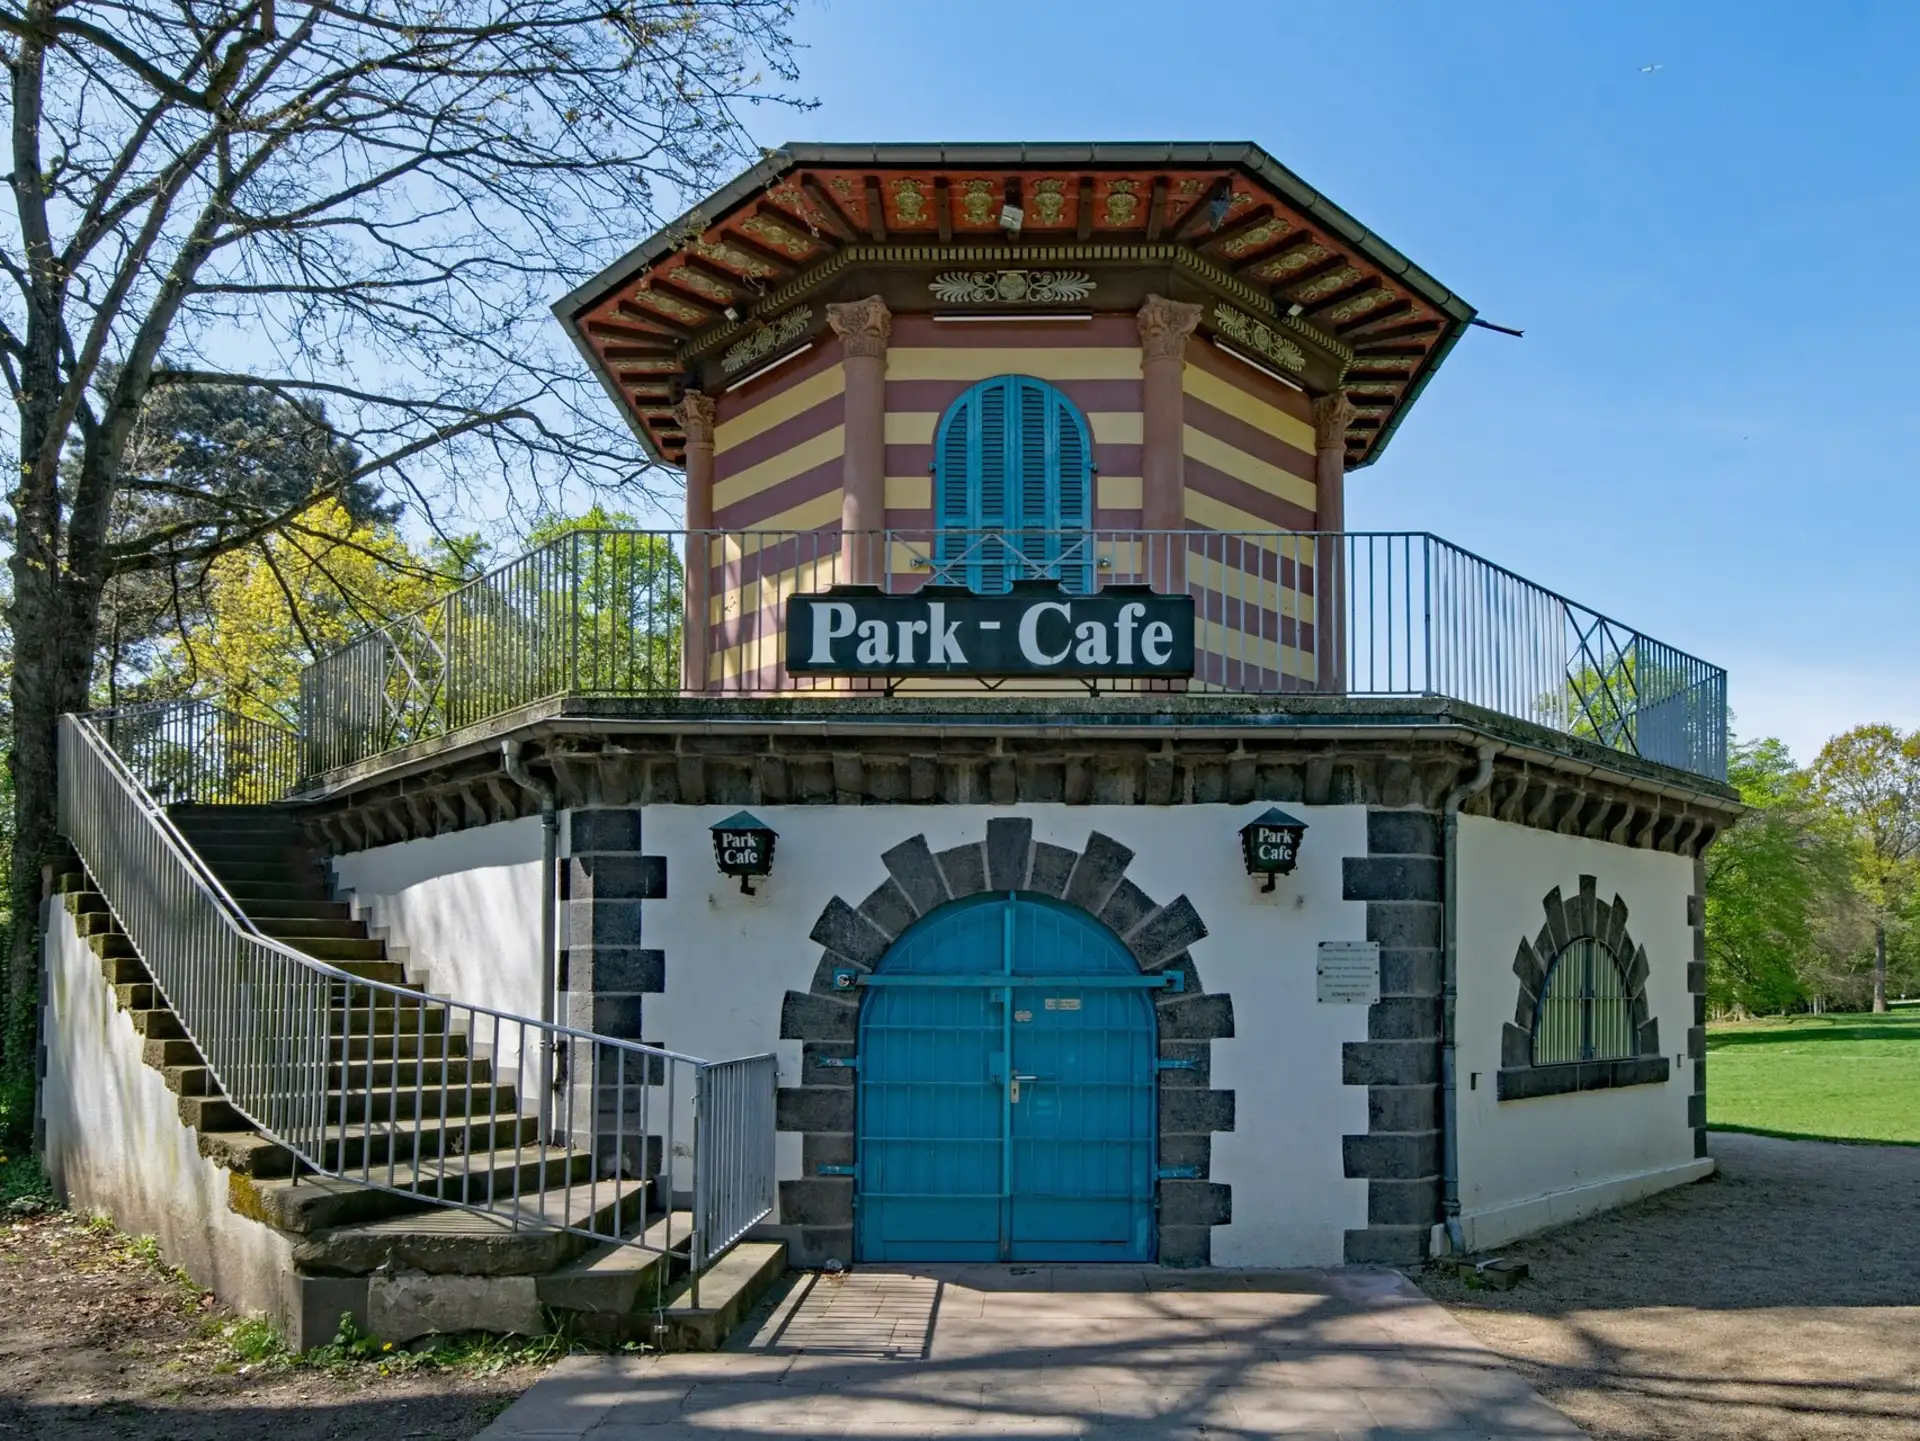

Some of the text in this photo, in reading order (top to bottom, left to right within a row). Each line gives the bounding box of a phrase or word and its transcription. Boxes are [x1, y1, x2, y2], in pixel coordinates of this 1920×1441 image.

[807, 602, 969, 664] Park
[1018, 601, 1173, 666] Cafe
[724, 849, 758, 864] Cafe
[1258, 844, 1292, 860] Cafe
